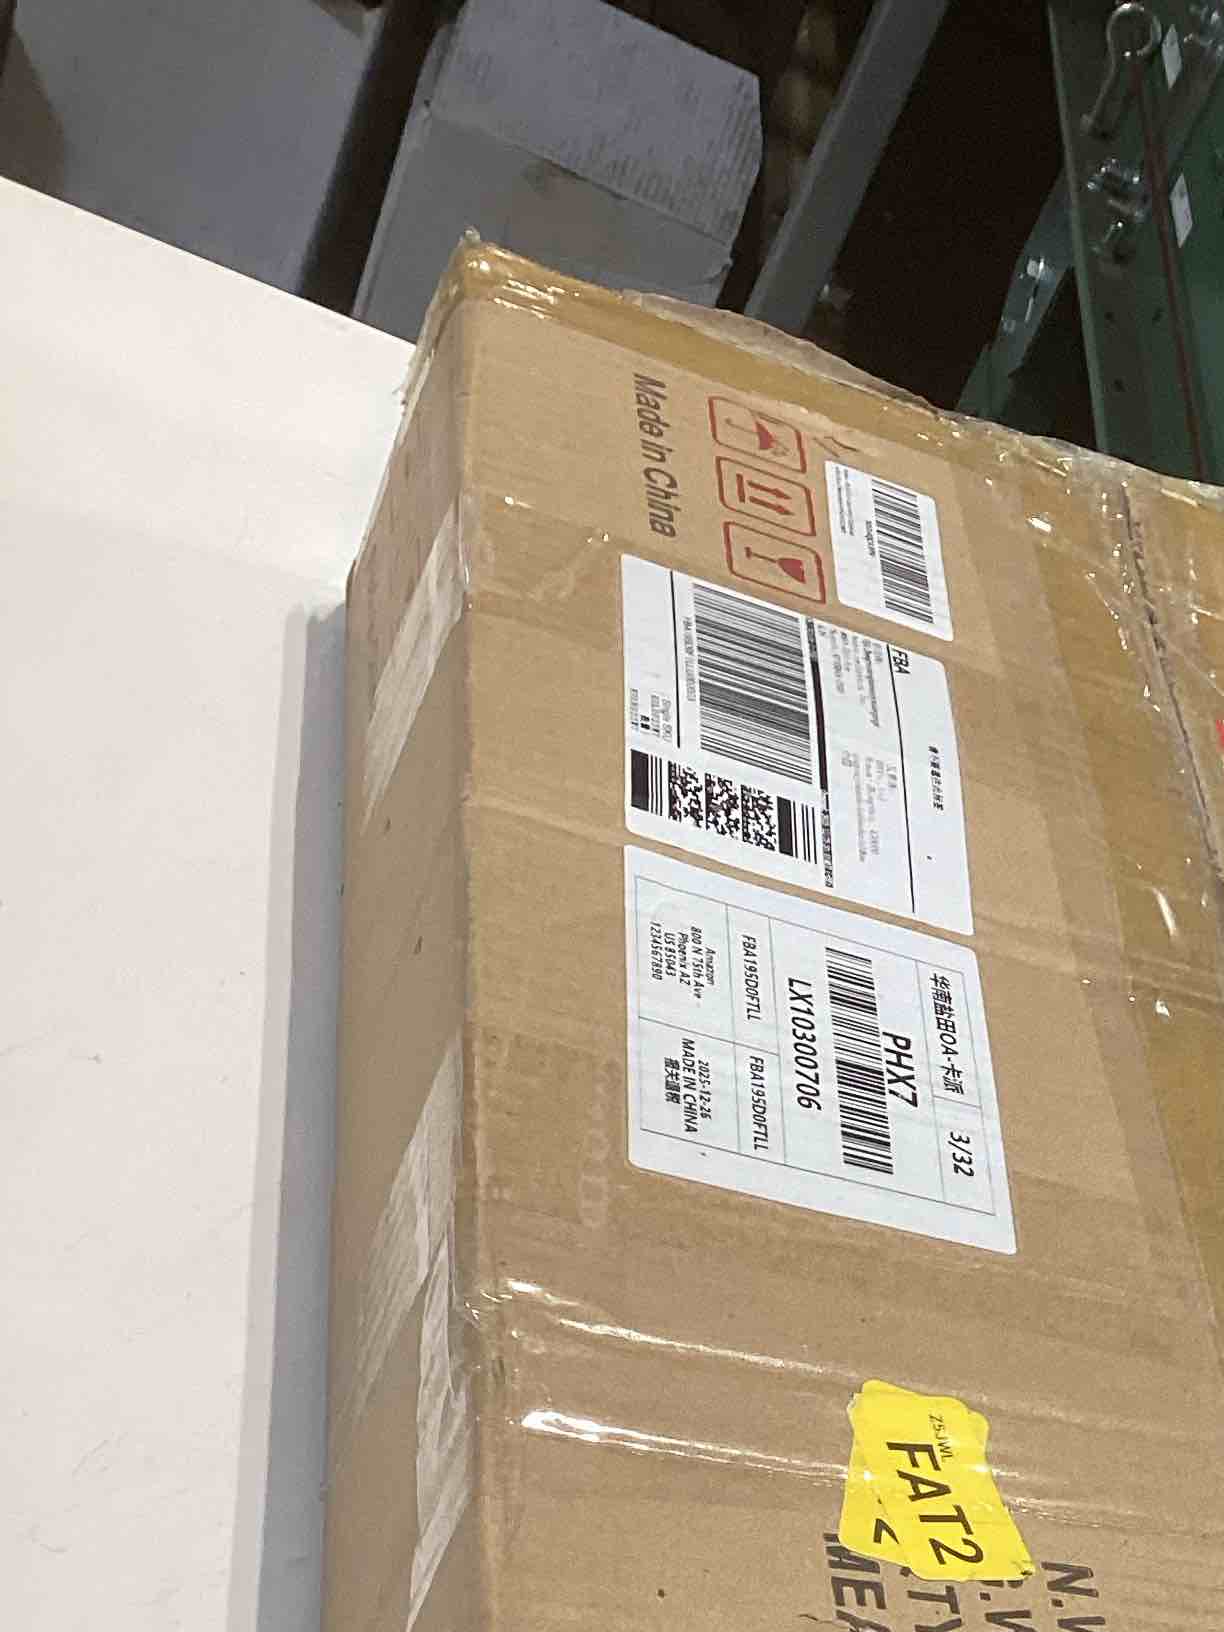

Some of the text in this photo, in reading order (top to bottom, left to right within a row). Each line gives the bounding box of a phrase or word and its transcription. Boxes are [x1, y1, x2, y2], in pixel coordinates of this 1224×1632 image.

[634, 374, 681, 538] Made in China
[893, 647, 910, 674] FBA
[651, 923, 663, 980] 1234567890
[664, 933, 675, 945] US
[678, 932, 690, 985] Phoenix AZ
[692, 947, 702, 955] N
[694, 980, 704, 998] Ave
[706, 948, 716, 985] Amazon
[789, 978, 821, 1110] LX10300706
[882, 1032, 918, 1107] PHX7
[682, 1039, 697, 1132] MADE IN CHINA
[948, 1132, 974, 1176] 3/32
[888, 1442, 983, 1564] FAT2
